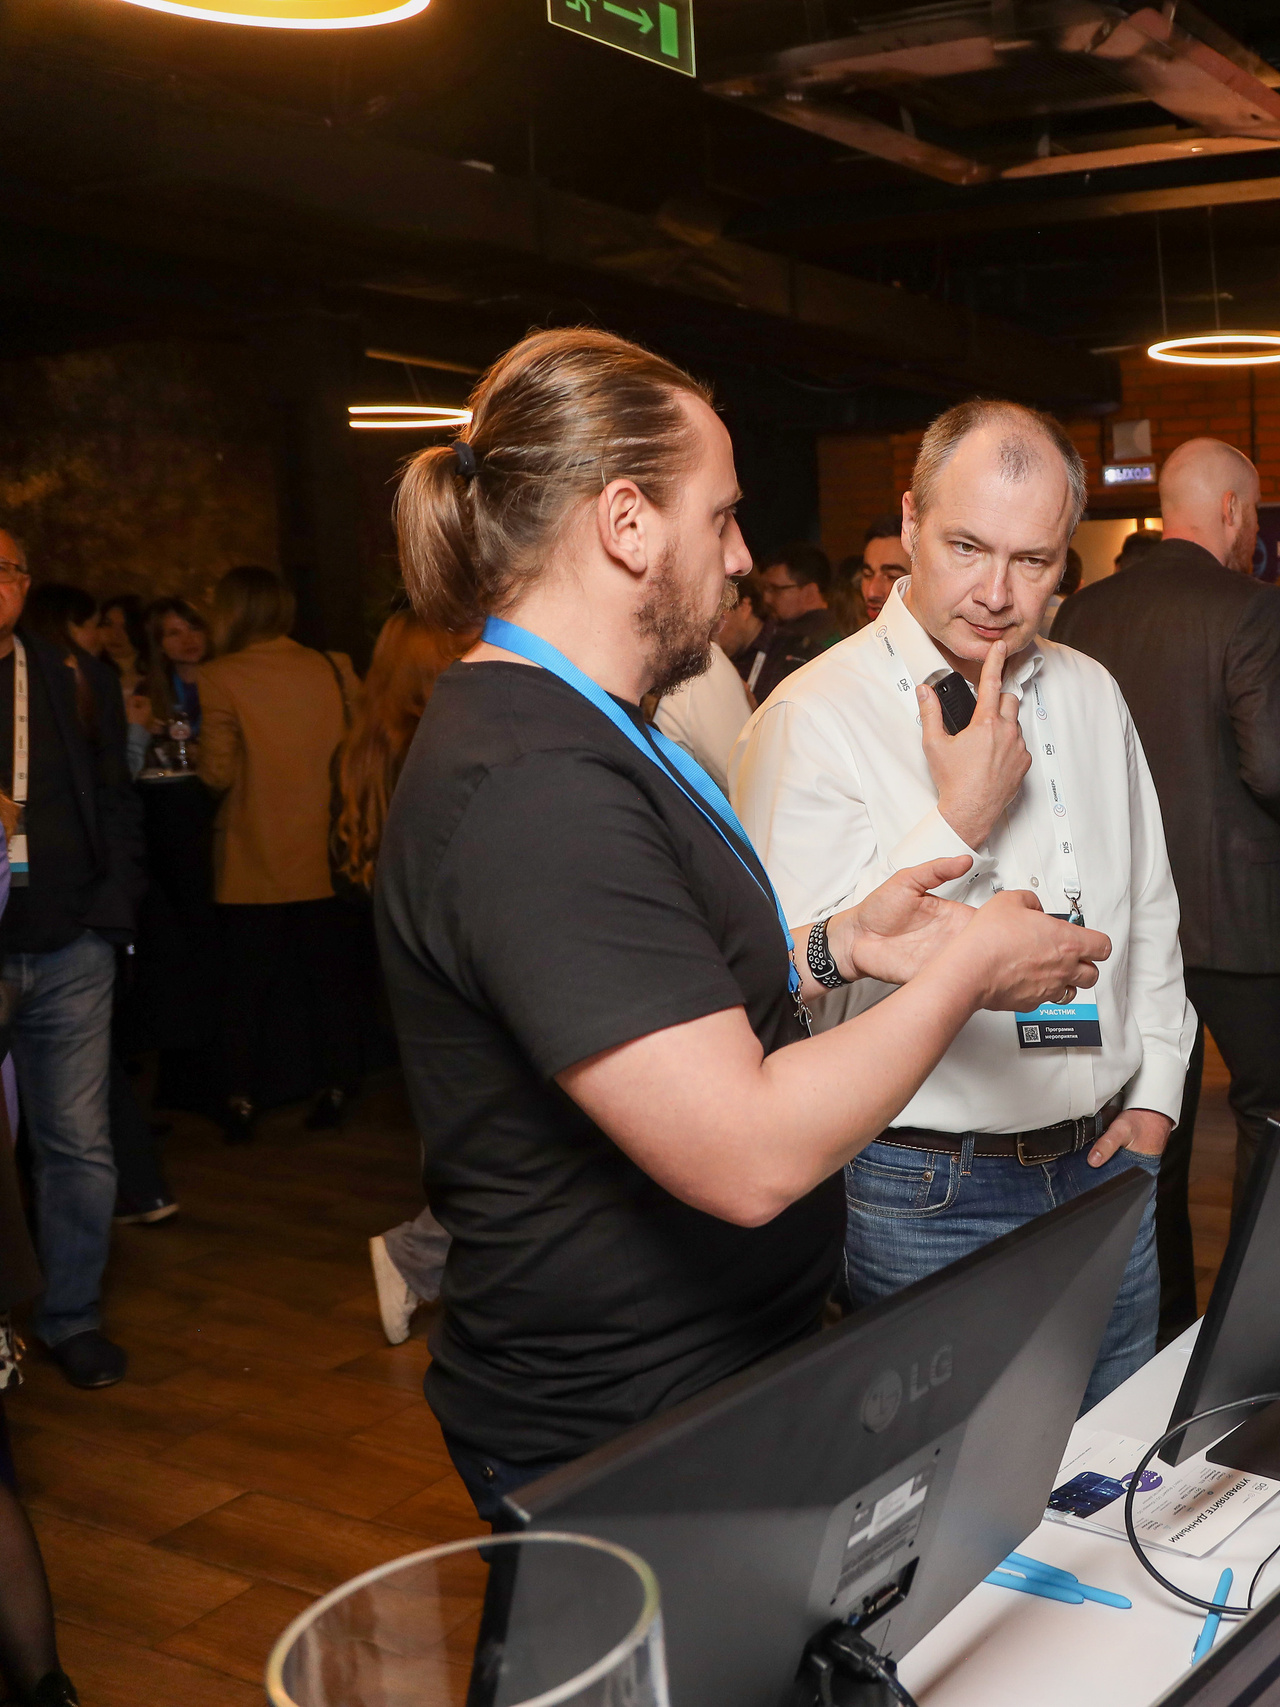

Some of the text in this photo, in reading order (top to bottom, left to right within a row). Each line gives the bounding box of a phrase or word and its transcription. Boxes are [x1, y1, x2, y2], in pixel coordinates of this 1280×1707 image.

[899, 678, 911, 692] DIS
[909, 1344, 952, 1403] LG
[1207, 1478, 1251, 1515] УПРАВЛЯЙТЕ
[1169, 1512, 1208, 1543] ДАННЫМИ
